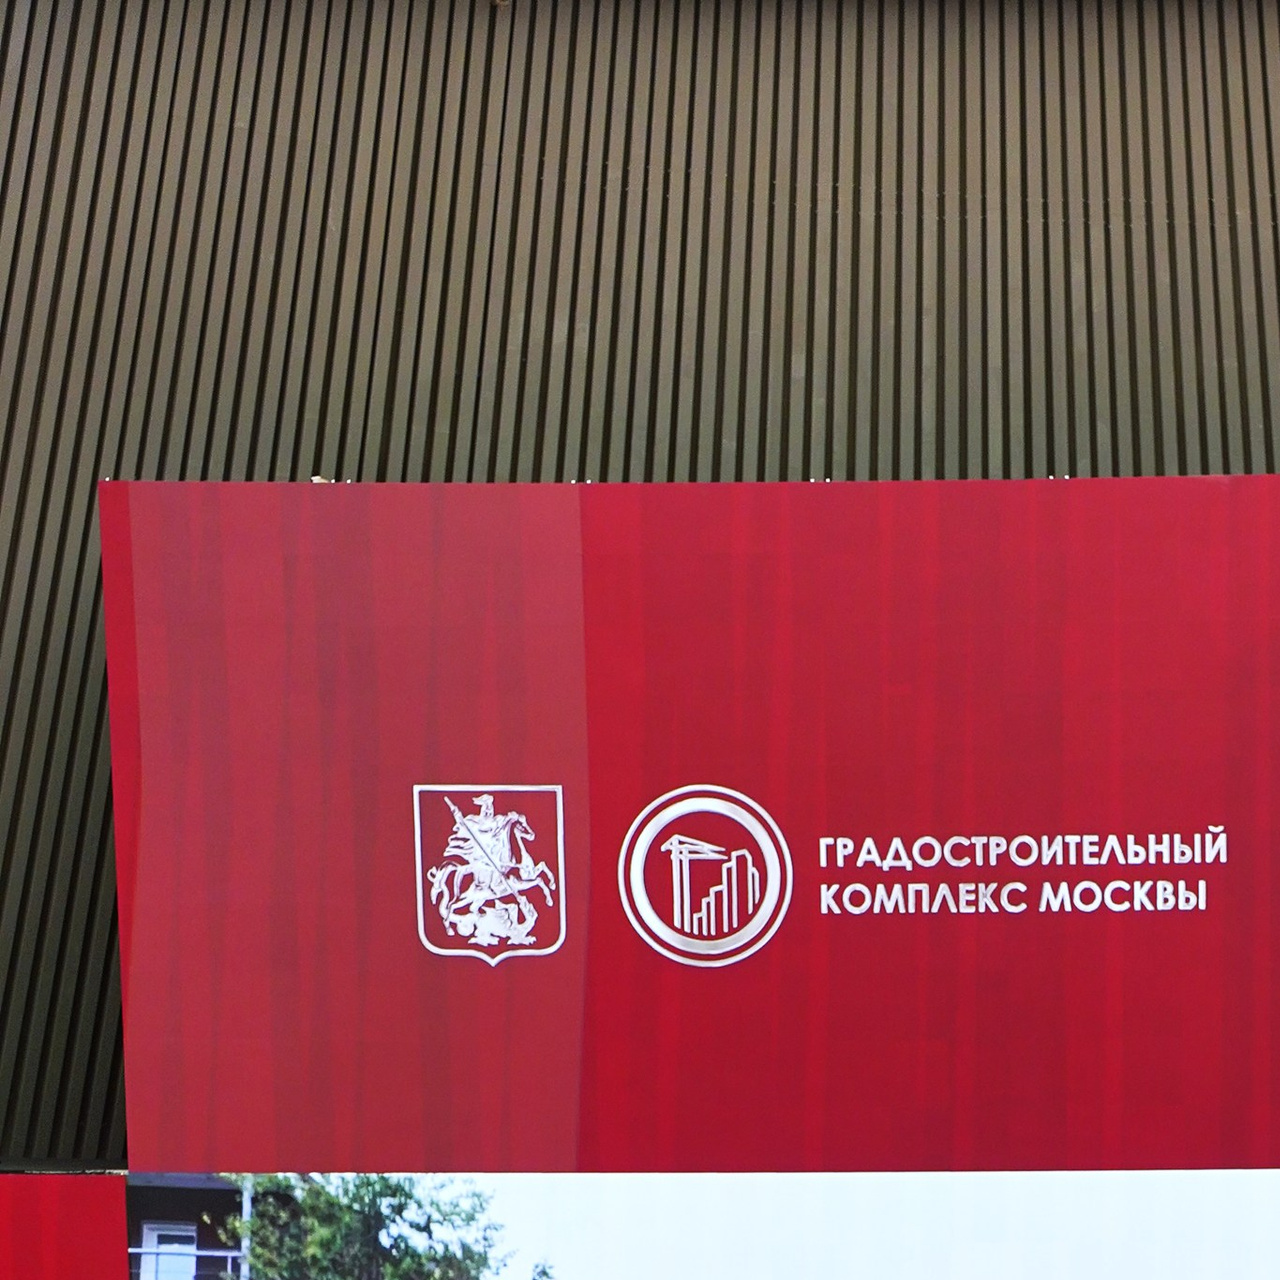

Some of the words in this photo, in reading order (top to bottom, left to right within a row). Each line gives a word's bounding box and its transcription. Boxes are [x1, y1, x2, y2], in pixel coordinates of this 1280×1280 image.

[819, 825, 1229, 871] ГРАДОСТРОИТЕЛЬНЫЙ
[820, 881, 1028, 915] КОМПЛЕКС
[1038, 879, 1207, 913] МОСКВЫ
